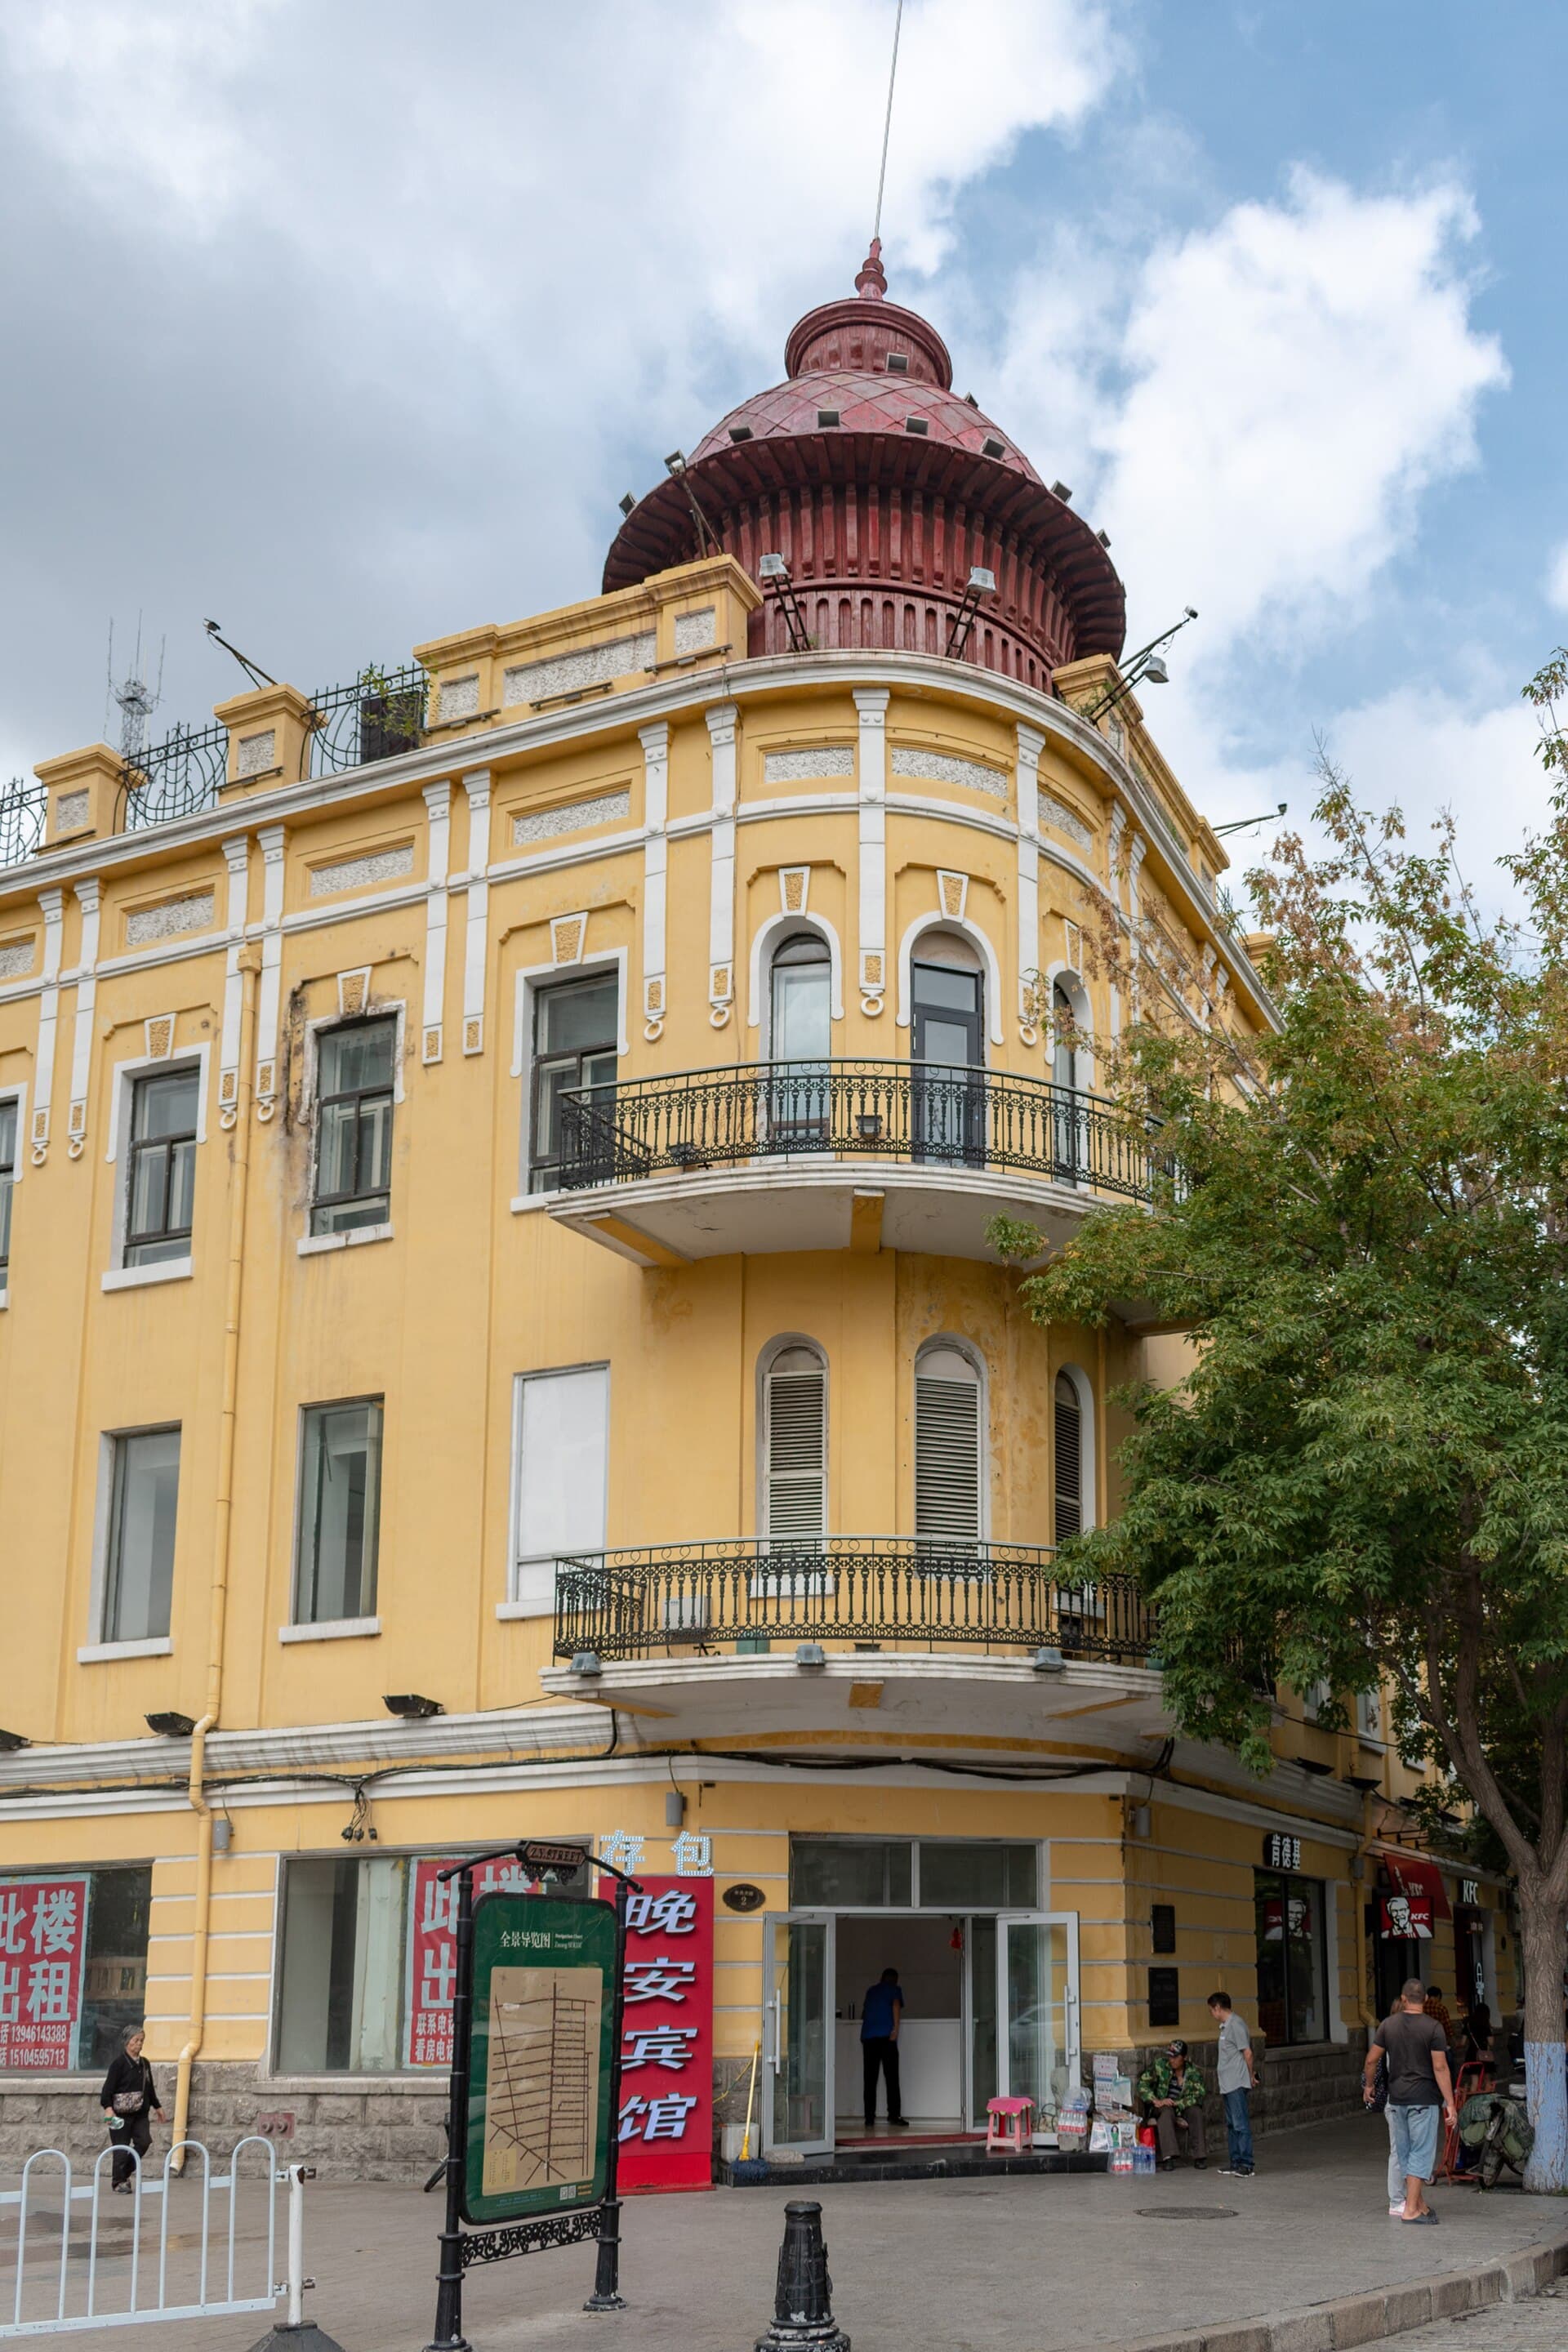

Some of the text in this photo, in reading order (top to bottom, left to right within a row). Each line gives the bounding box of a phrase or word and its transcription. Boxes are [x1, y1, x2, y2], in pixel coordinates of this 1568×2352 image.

[599, 1829, 714, 1877] 存包
[1272, 1833, 1301, 1870] 肯德基
[1463, 1879, 1478, 1905] KFC
[1410, 1913, 1429, 1921] KFC
[501, 1931, 550, 1949] 全景导览图
[618, 1889, 698, 2143] 晚安宾馆
[11, 2025, 67, 2042] 13946143388
[10, 2048, 65, 2066] 15104595713
